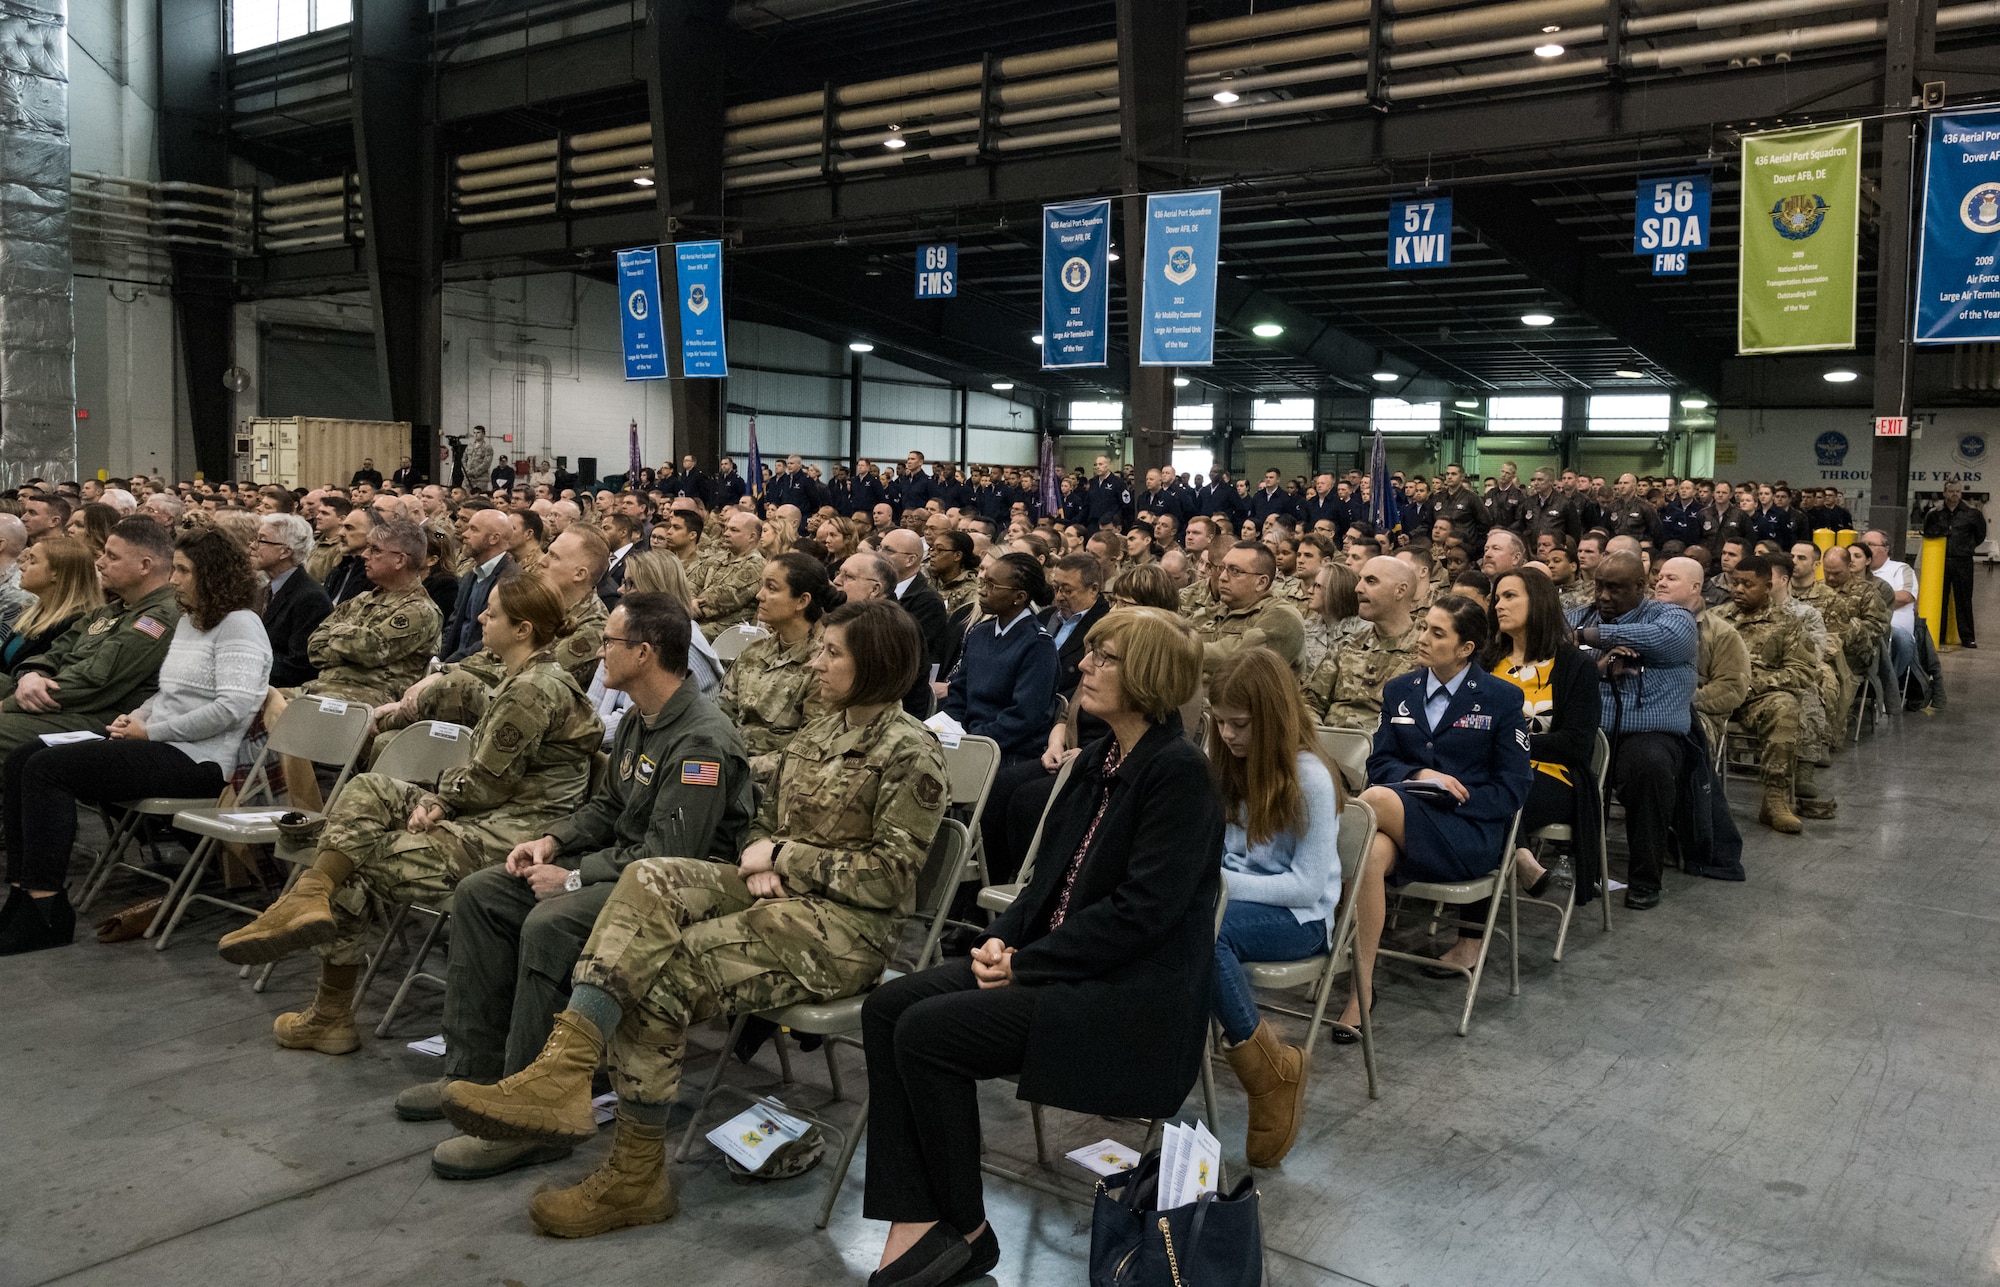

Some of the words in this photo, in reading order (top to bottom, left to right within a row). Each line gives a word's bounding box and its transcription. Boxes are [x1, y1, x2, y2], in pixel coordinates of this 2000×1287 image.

[1942, 133, 1958, 144] 436
[1959, 131, 1984, 143] Aerial
[1985, 131, 2000, 141] Por
[1755, 156, 1768, 166] 436
[1770, 153, 1792, 164] Aerial
[1793, 151, 1809, 161] Port
[1811, 147, 1847, 160] Squadron
[1962, 153, 1988, 164] Dover
[1989, 150, 2000, 161] AF
[1774, 174, 1796, 184] Dover
[1797, 171, 1814, 181] AFB,
[1816, 169, 1826, 179] DE
[1654, 181, 1693, 214] 56
[1164, 210, 1177, 218] Aerial
[1189, 207, 1212, 217] Squadron
[1404, 203, 1435, 232] 57
[1082, 217, 1103, 227] Squadron
[1180, 224, 1190, 233] AFB,
[1192, 224, 1199, 232] DE
[1641, 215, 1702, 249] SDA
[1085, 232, 1091, 241] DE
[1395, 234, 1444, 264] KWI
[926, 246, 947, 270] 69
[1655, 253, 1685, 272] FMS
[1975, 256, 1994, 266] 2009
[919, 271, 953, 295] FMS
[1766, 279, 1801, 287] Transportation
[1966, 274, 1978, 284] Air
[1979, 274, 2000, 283] Force
[1777, 291, 1806, 299] Outstanding
[1940, 292, 1960, 303] Large
[1961, 291, 1973, 300] Air
[1973, 289, 2000, 299] Termin
[1162, 311, 1179, 320] Mobility
[1960, 310, 1968, 320] of
[1969, 310, 1982, 319] the
[1984, 310, 2000, 319] Year
[1053, 332, 1063, 340] Large
[1154, 327, 1166, 335] Large
[1881, 419, 1903, 434] EXIT
[1820, 470, 1872, 480] THROU
[1909, 472, 1926, 480] HE
[1932, 472, 1982, 481] YEARS
